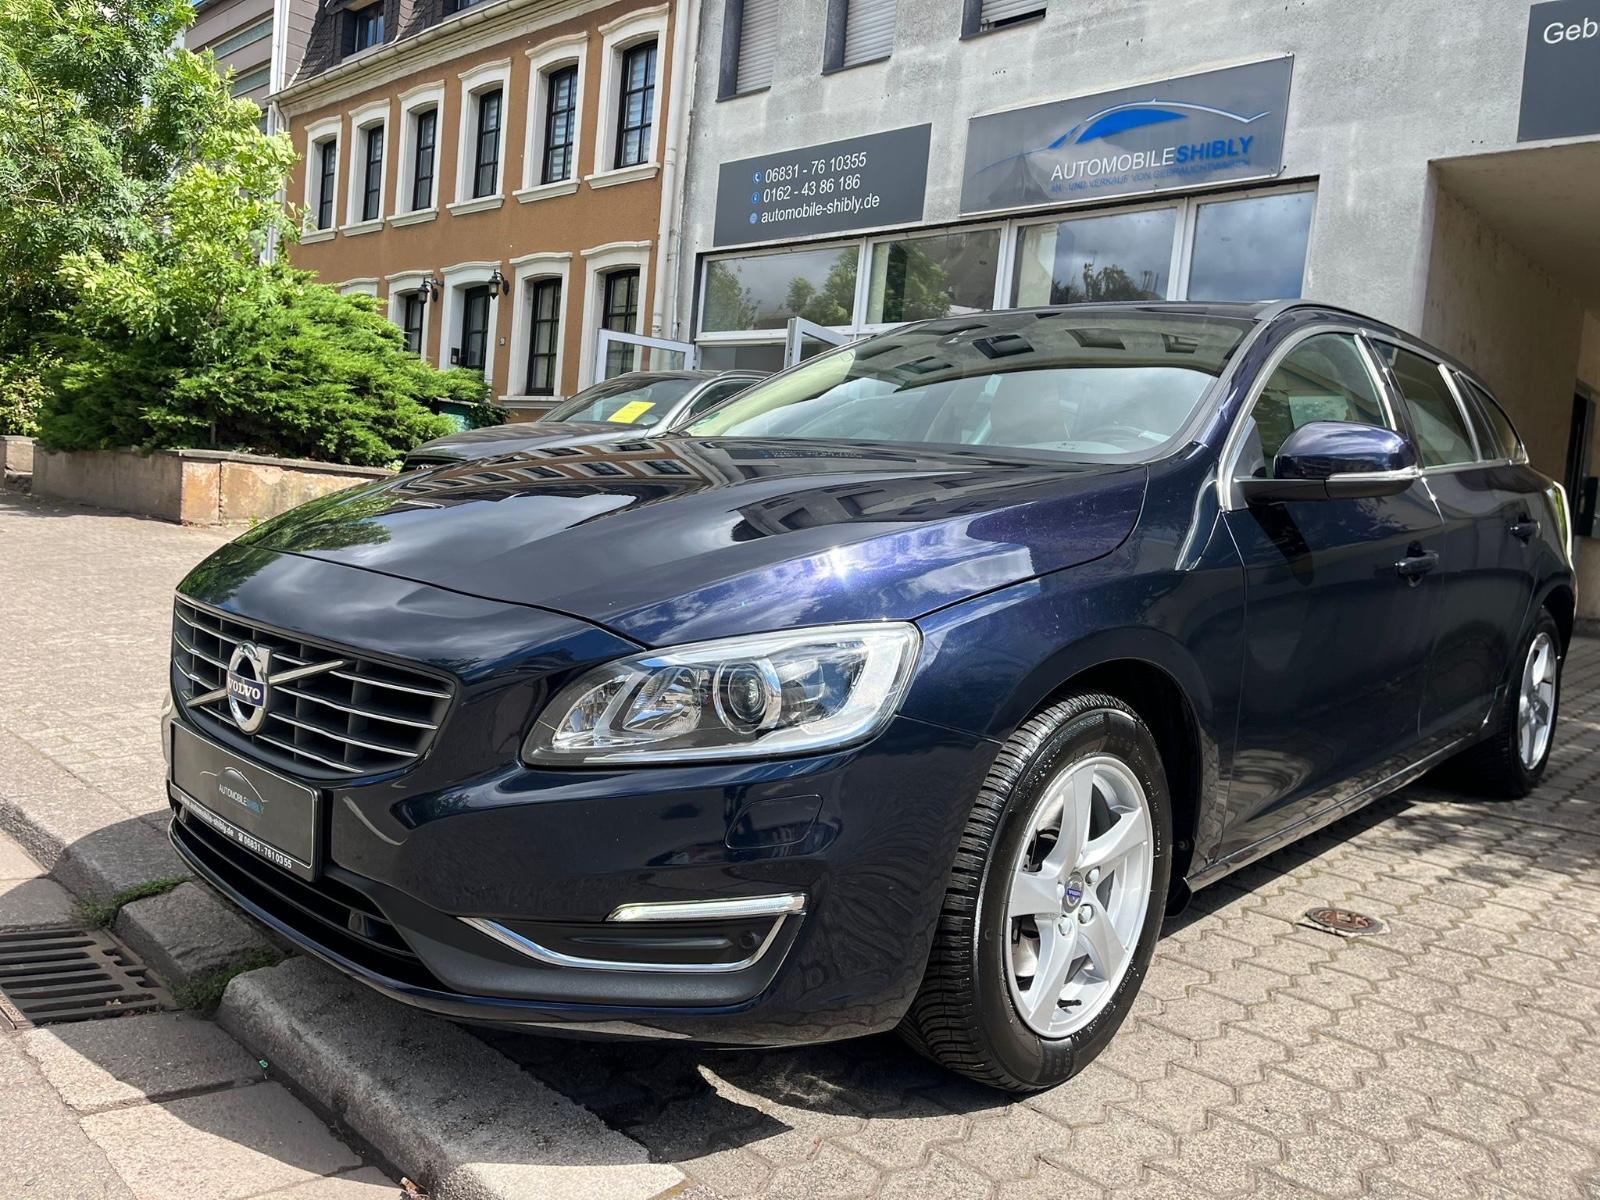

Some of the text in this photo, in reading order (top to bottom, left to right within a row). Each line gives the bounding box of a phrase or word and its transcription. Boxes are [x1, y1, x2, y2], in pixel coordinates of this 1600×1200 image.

[1543, 17, 1598, 44] Geb
[765, 164, 799, 184] 06831
[811, 159, 826, 175] 76
[829, 151, 867, 173] 10355
[763, 185, 791, 203] 0162
[801, 181, 816, 197] 43
[819, 177, 834, 194] 86
[838, 173, 861, 191] 186
[761, 192, 880, 223] automobile-shibly.de
[229, 679, 261, 700] VOLVO
